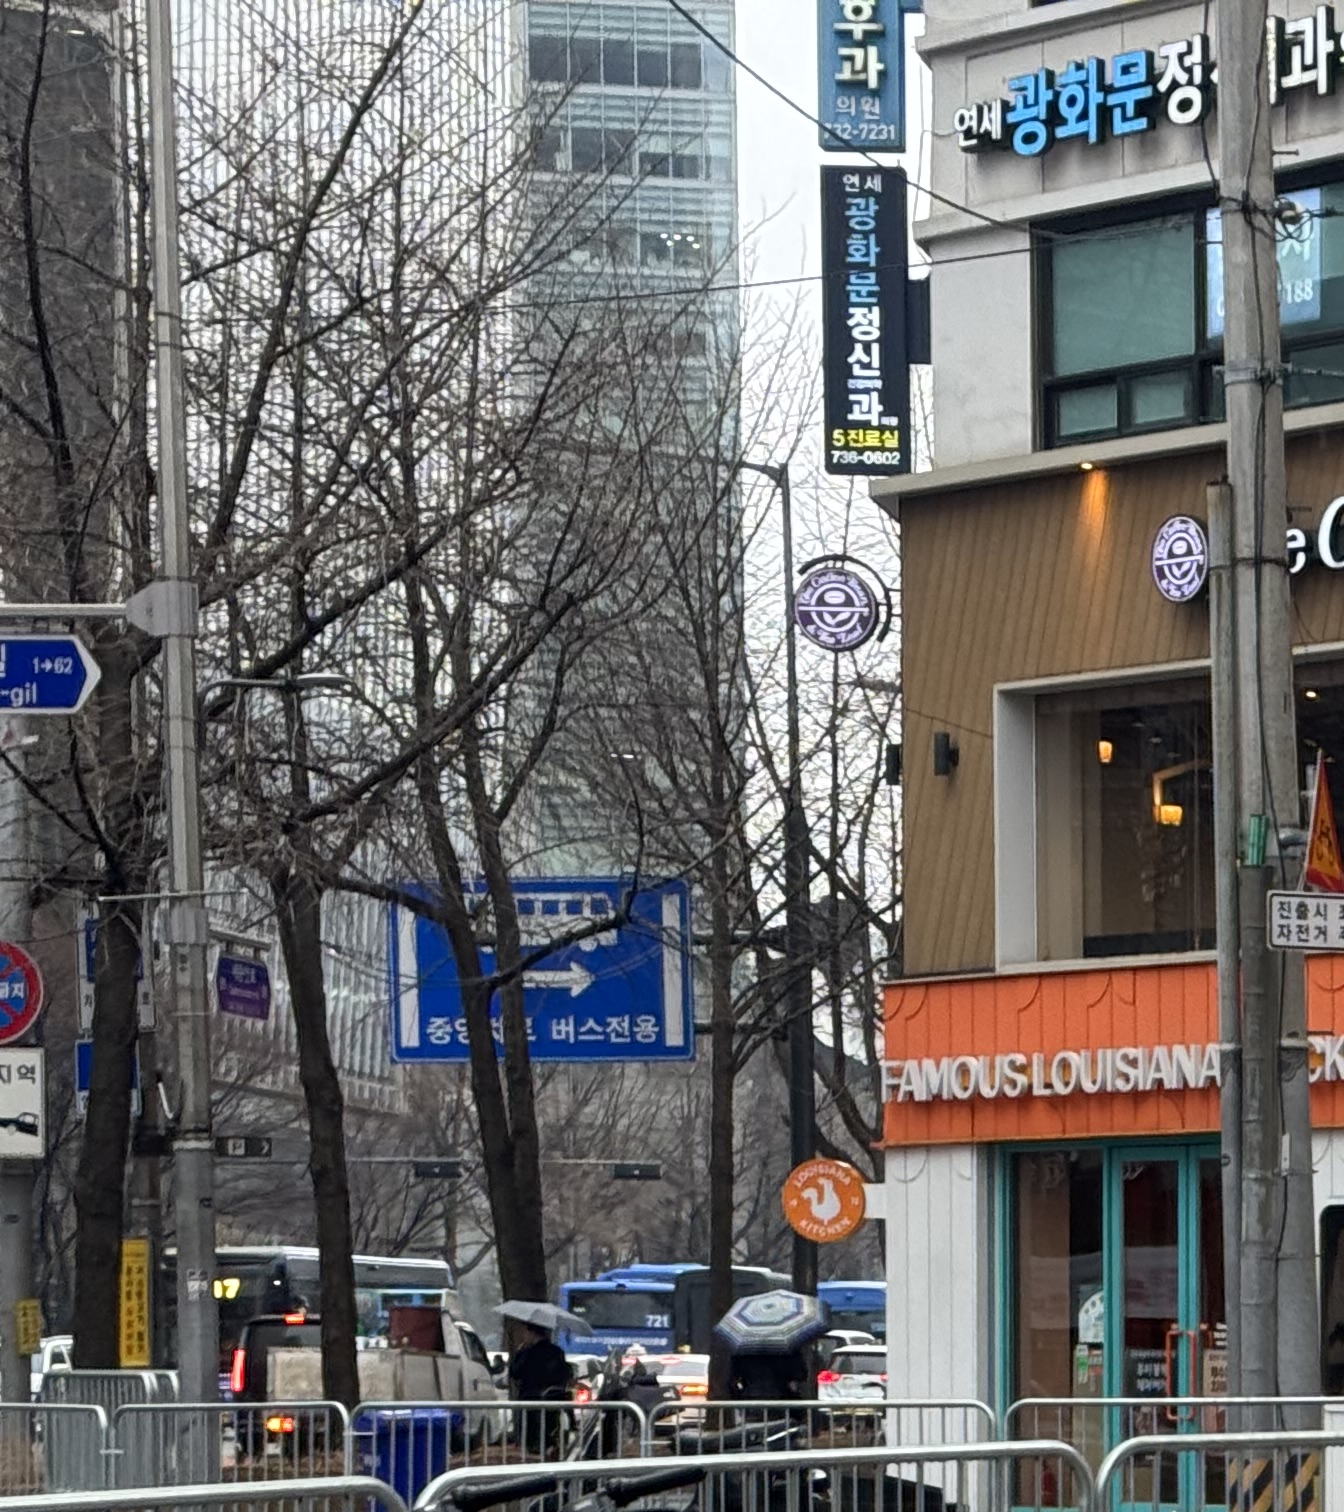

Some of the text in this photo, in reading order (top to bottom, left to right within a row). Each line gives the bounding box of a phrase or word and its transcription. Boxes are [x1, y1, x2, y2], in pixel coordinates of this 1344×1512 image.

[836, 96, 880, 119] 의원
[954, 99, 1001, 146] 연세
[842, 173, 882, 193] 연세
[1277, 923, 1329, 944] 자전거
[551, 1014, 660, 1044] 버스전용
[881, 1051, 1028, 1103] FAMOUS
[645, 1314, 671, 1328] 721
